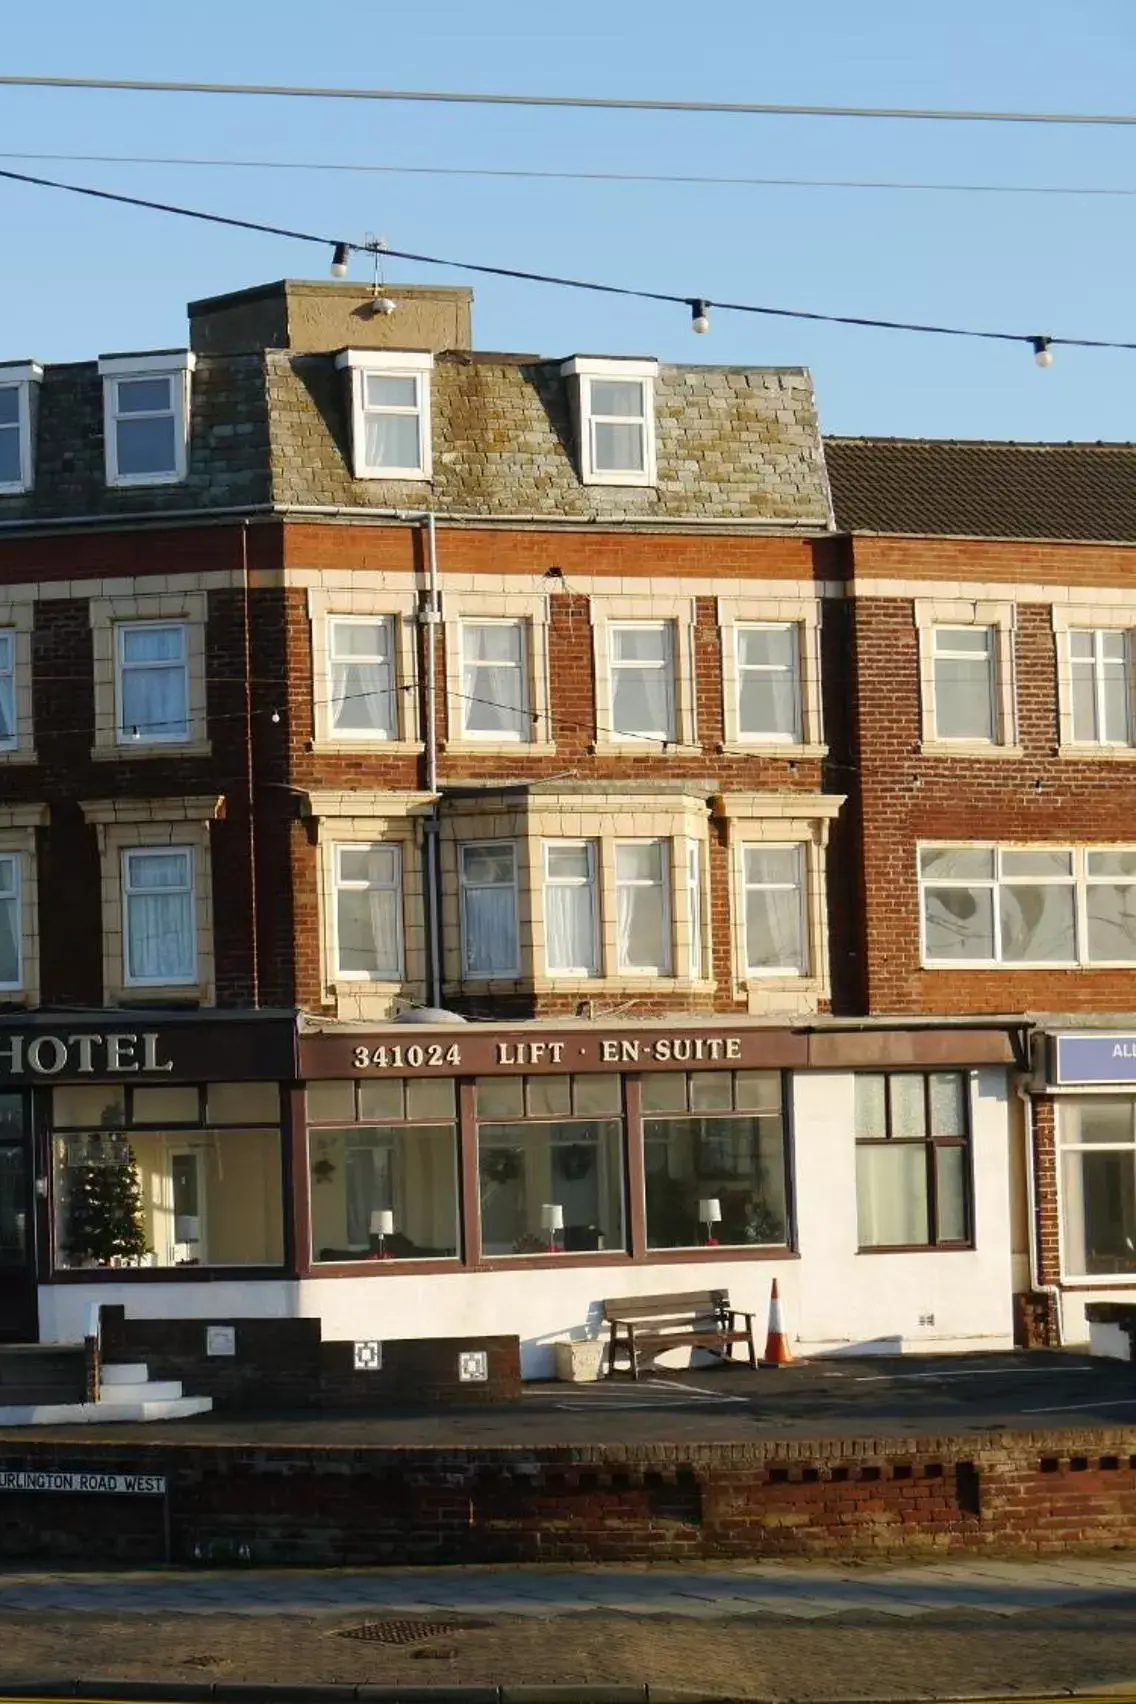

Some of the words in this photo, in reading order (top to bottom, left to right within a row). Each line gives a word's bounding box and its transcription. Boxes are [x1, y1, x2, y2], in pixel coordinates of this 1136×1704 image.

[353, 1043, 462, 1068] 341024
[498, 1041, 565, 1065] LIFT
[602, 1037, 742, 1063] EN-SUITE
[80, 1475, 117, 1491] ROAD
[124, 1477, 163, 1492] WEST
